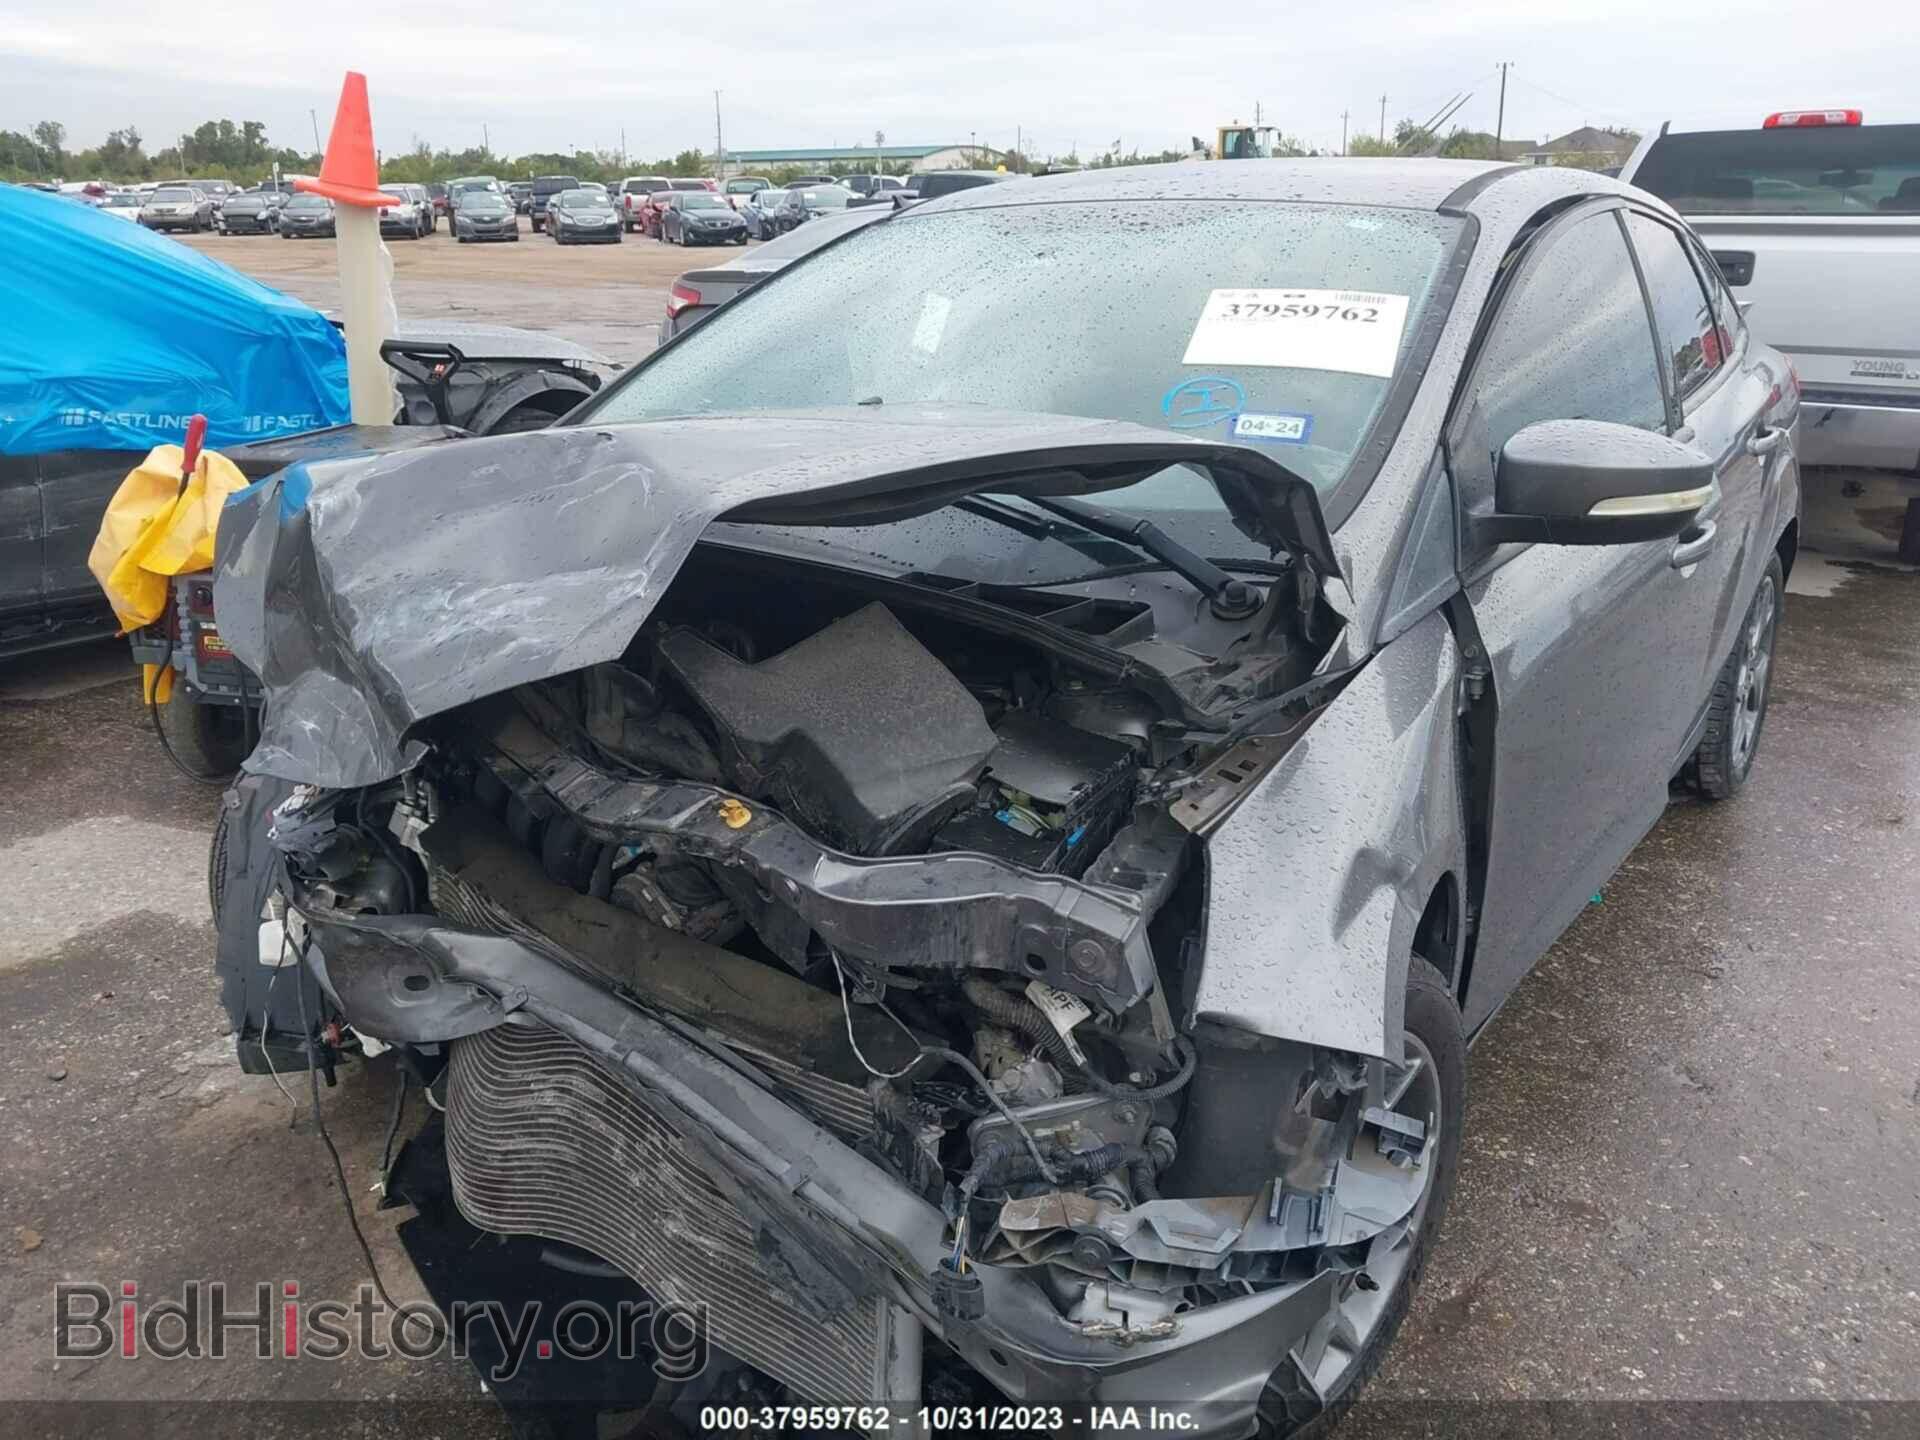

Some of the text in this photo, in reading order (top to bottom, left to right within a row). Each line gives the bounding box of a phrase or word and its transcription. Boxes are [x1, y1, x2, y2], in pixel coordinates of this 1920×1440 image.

[1221, 303, 1379, 323] 37959762
[1851, 360, 1905, 372] YOUNG
[1240, 419, 1300, 435] 04 24
